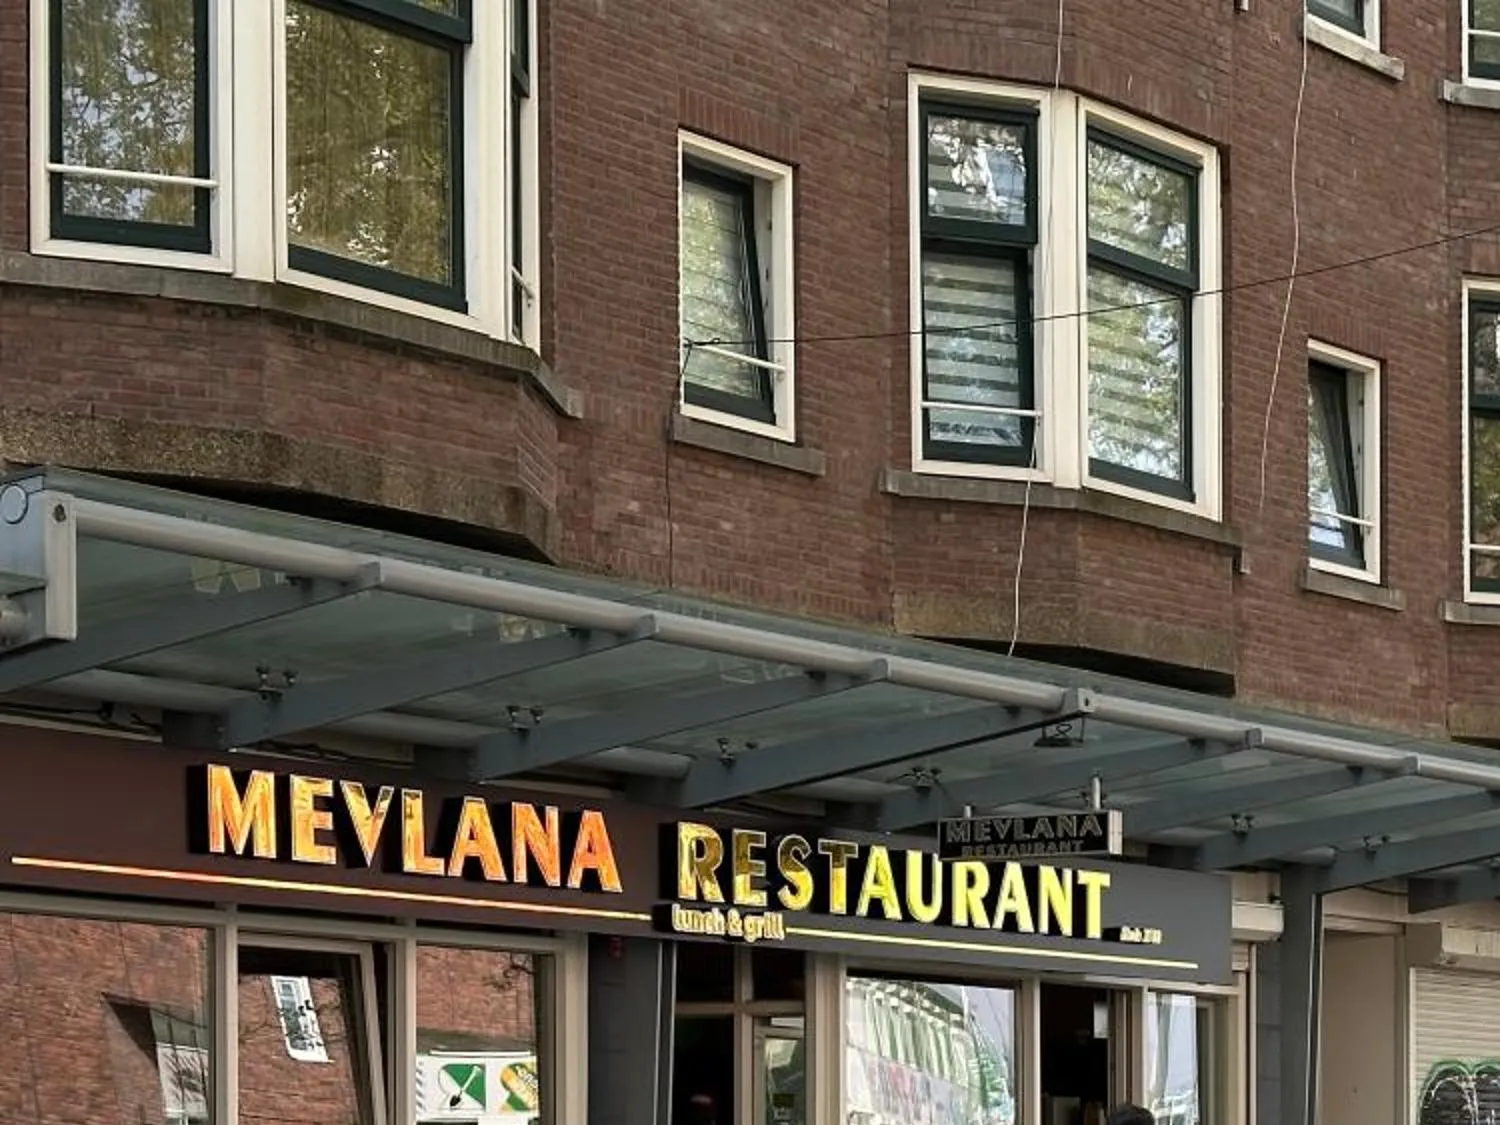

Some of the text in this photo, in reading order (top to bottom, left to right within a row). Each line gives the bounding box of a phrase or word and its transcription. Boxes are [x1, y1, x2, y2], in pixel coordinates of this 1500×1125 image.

[207, 764, 623, 893] MEVLANA
[947, 815, 1103, 843] MEVLANA
[961, 840, 1084, 857] RESTAURANT
[677, 821, 1111, 939] RESTAURANT
[744, 911, 785, 942] grill
